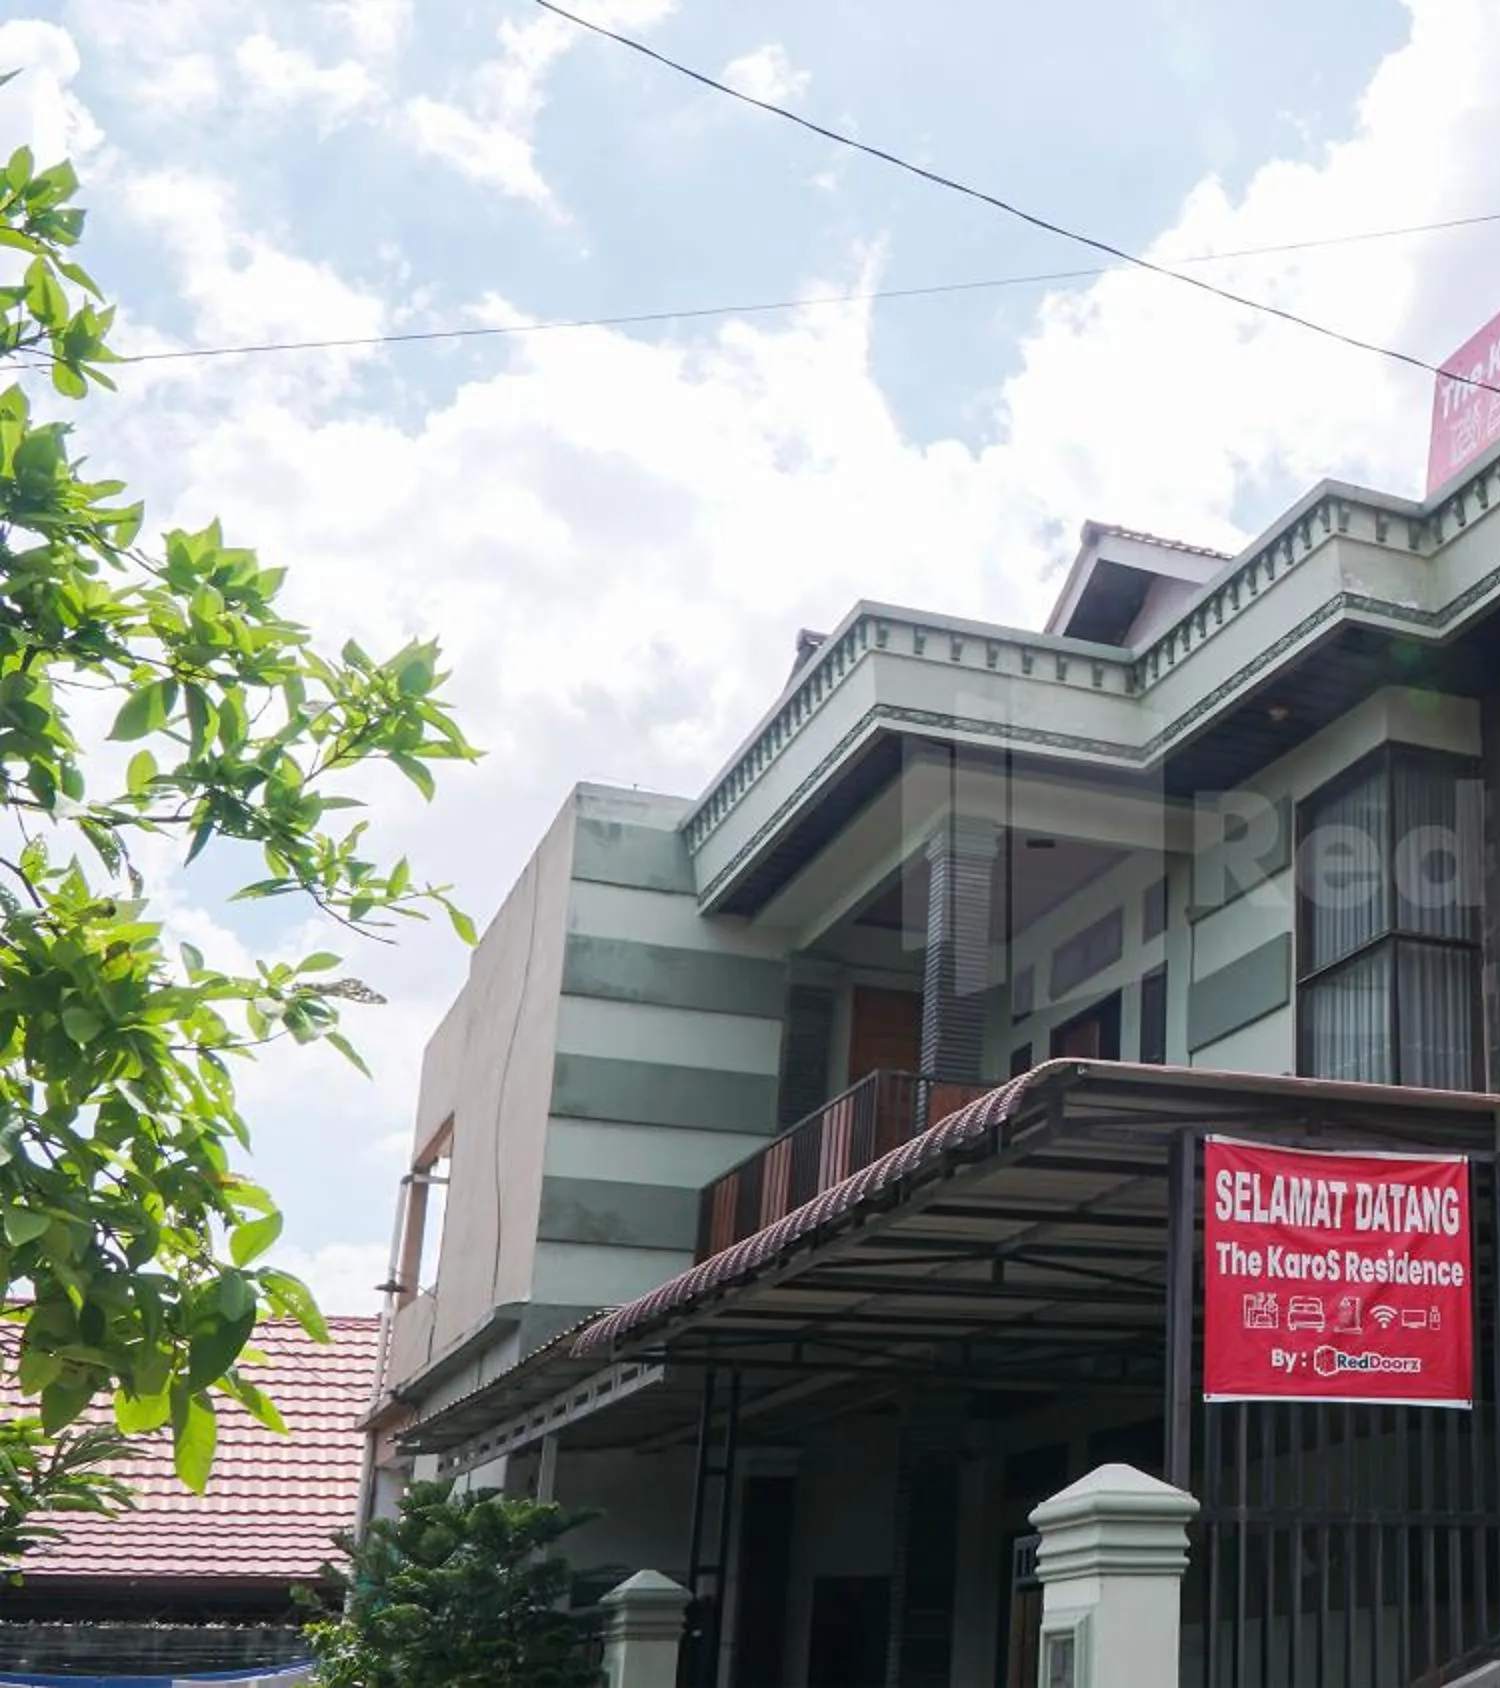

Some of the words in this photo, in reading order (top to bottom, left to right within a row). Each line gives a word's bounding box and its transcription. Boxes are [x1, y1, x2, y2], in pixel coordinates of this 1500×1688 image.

[1440, 363, 1484, 420] The
[1215, 1169, 1348, 1230] SELAMAT
[1354, 1182, 1460, 1236] DATANG
[1215, 1241, 1263, 1278] The
[1267, 1246, 1341, 1282] KaroS
[1345, 1249, 1465, 1287] Residence
[1335, 1351, 1421, 1372] RedDoorz
